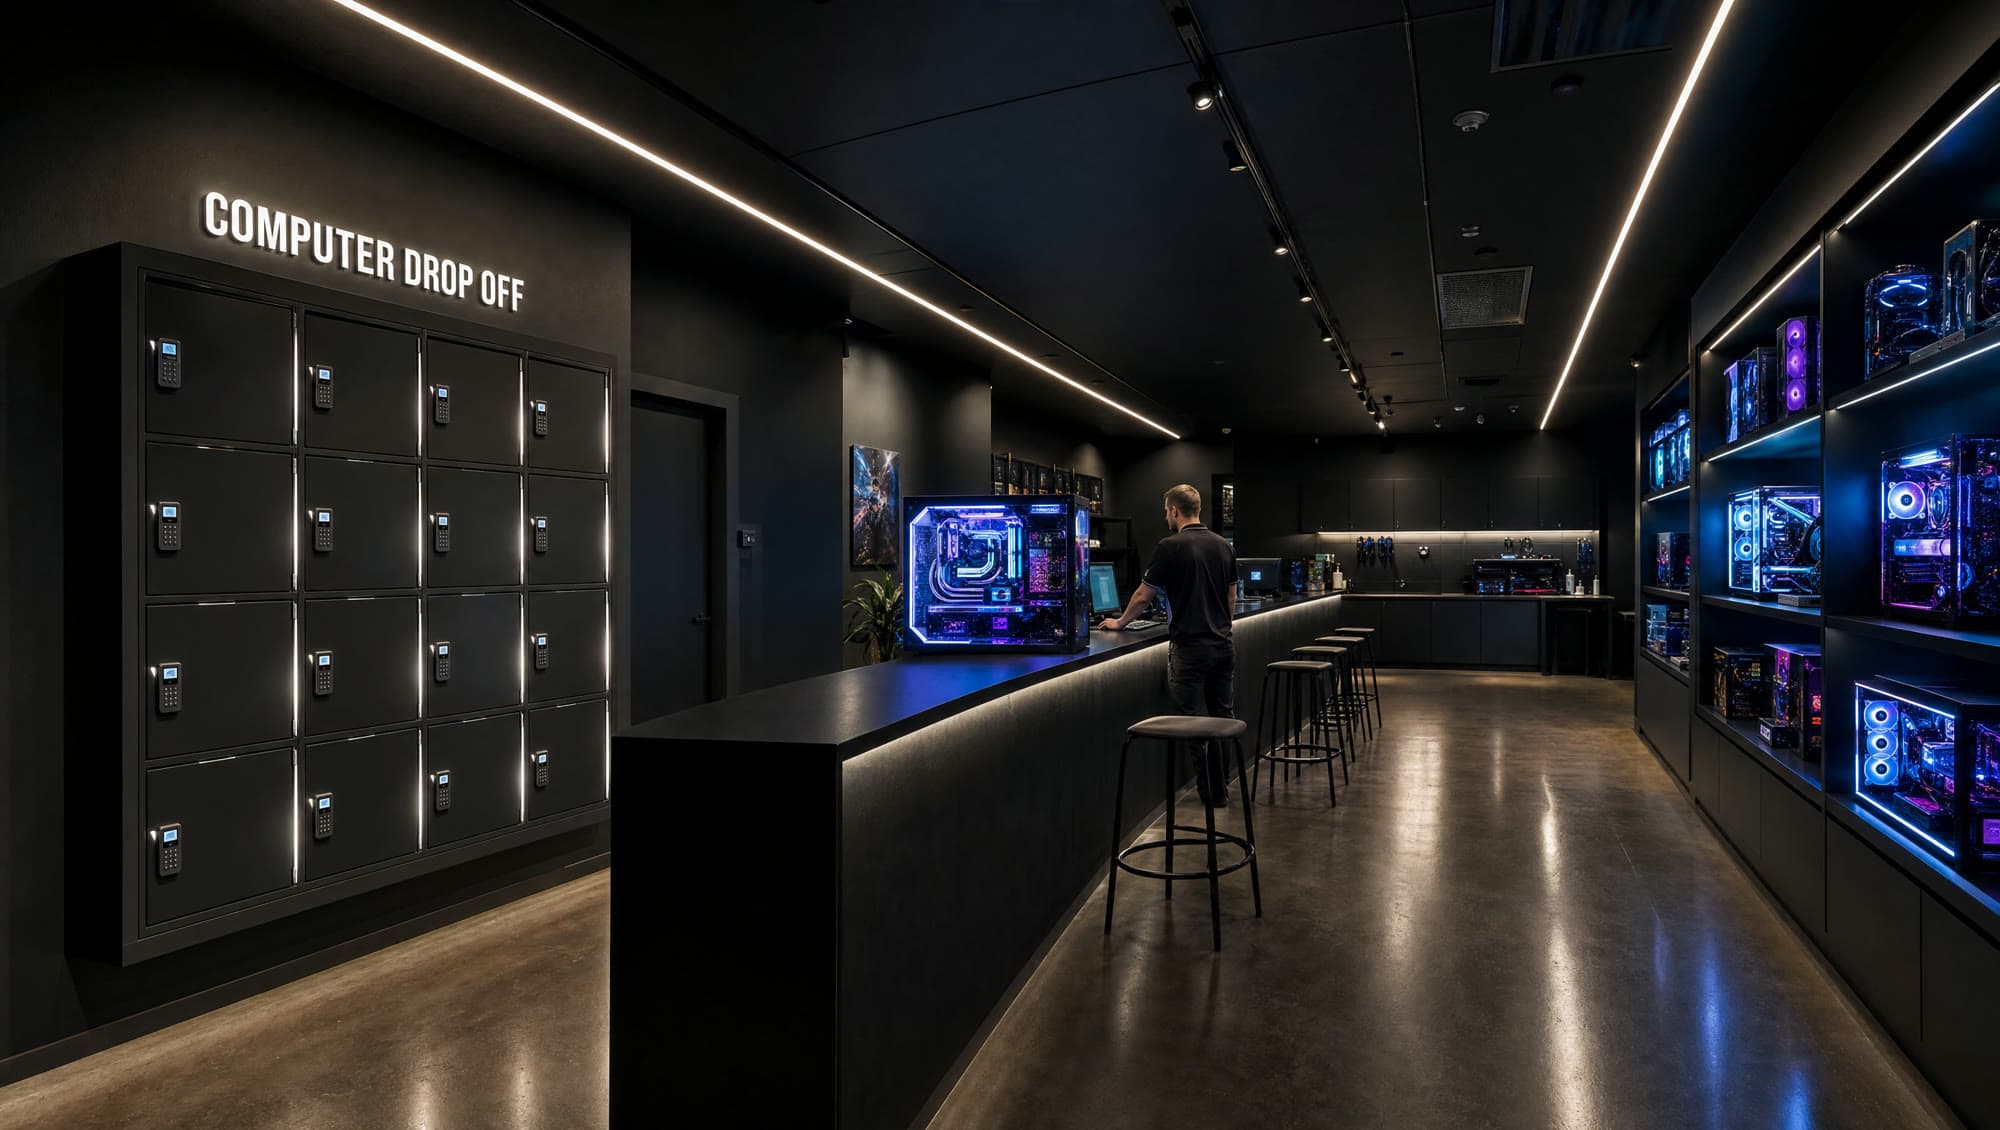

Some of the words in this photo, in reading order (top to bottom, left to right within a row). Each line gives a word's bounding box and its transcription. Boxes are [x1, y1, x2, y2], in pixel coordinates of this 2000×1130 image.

[205, 191, 395, 281] COMPUTER
[404, 247, 473, 299] DROP
[481, 270, 525, 312] OFF
